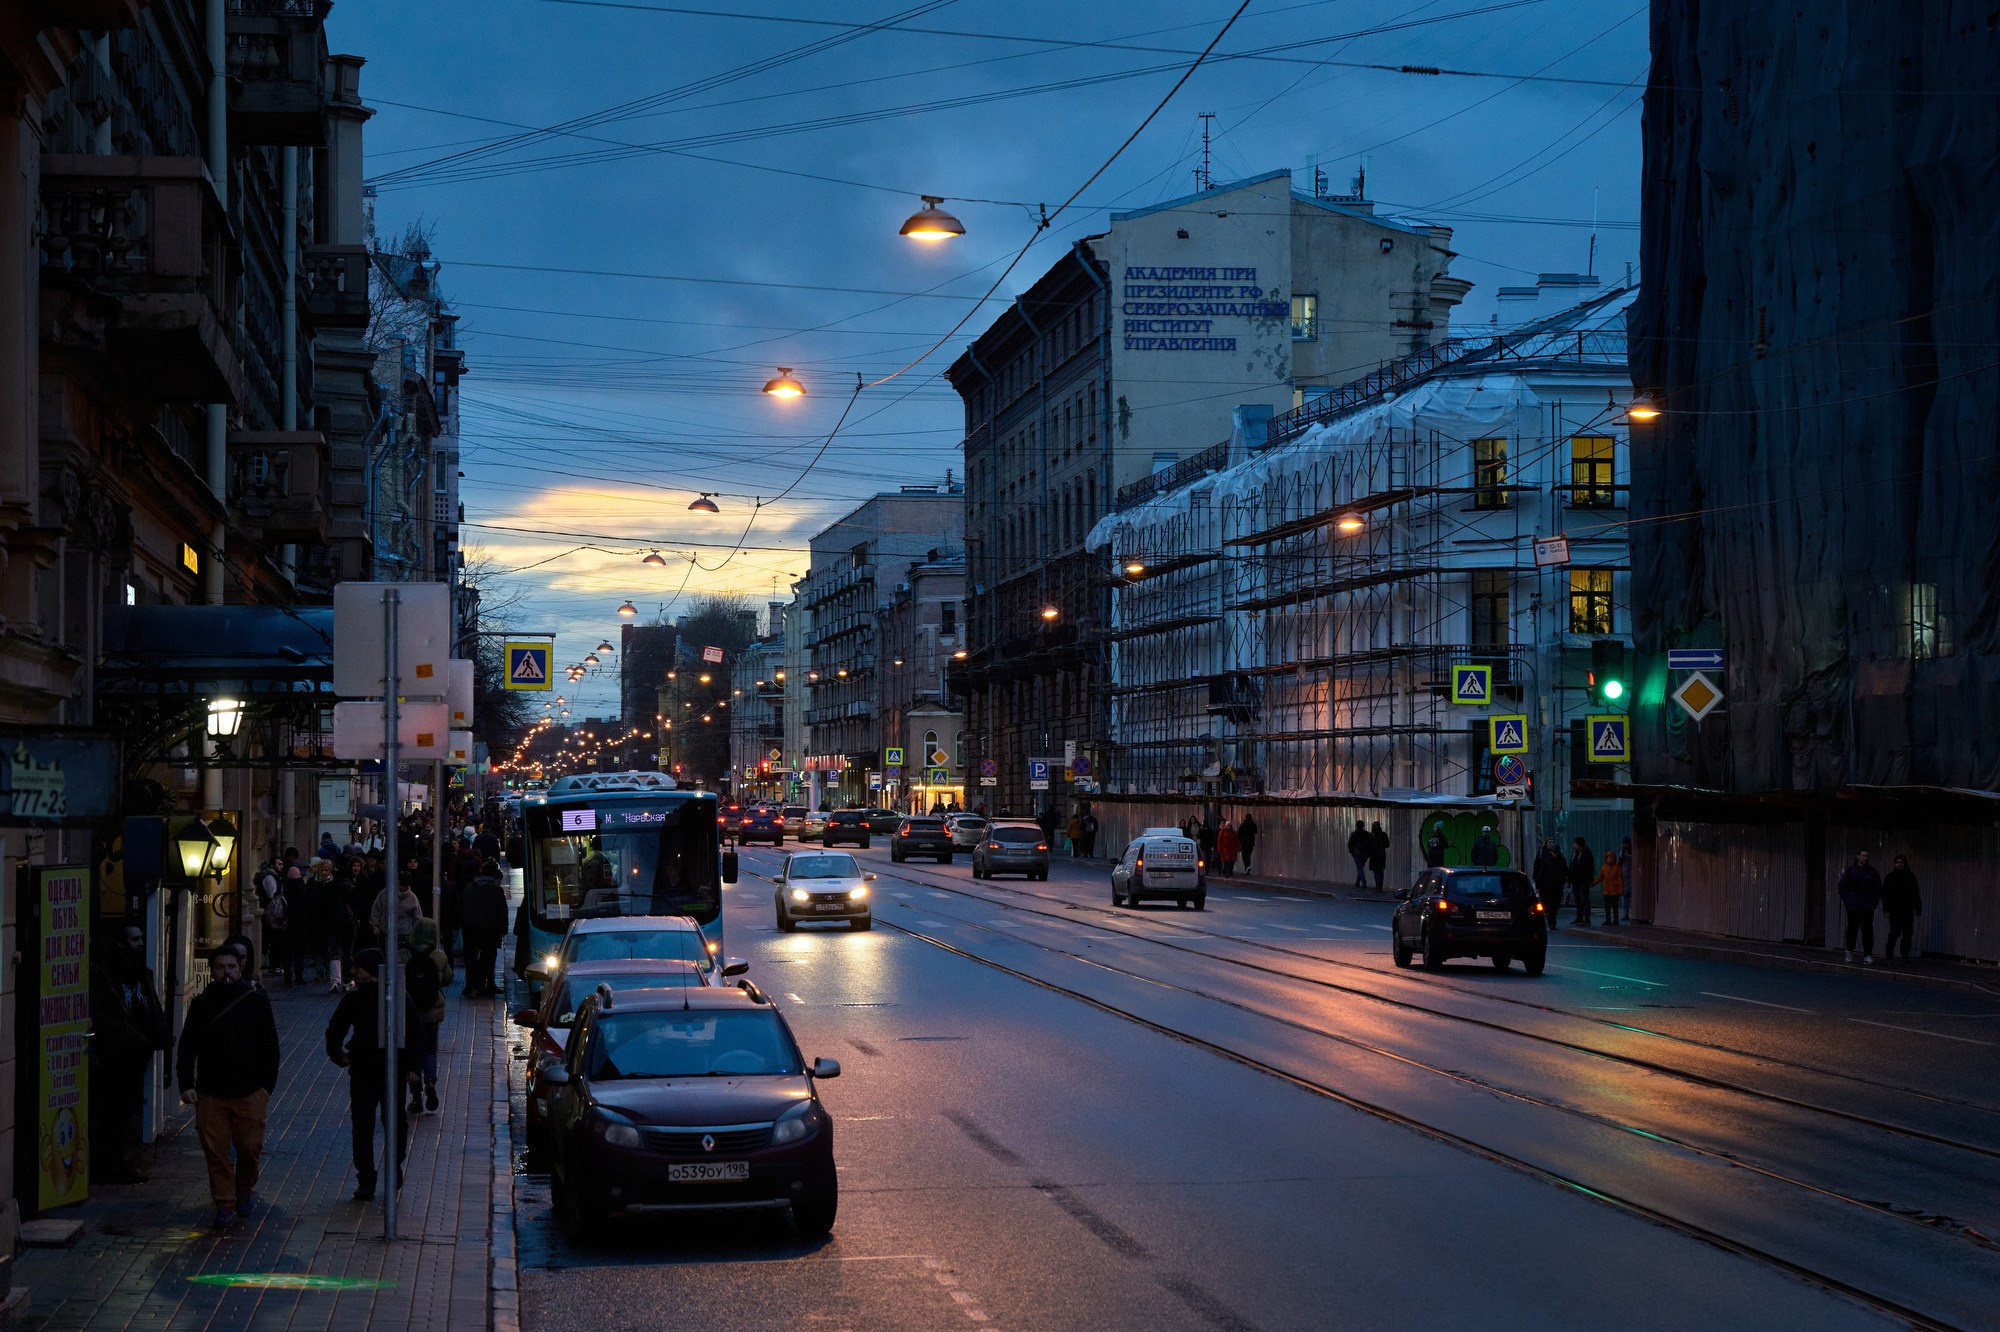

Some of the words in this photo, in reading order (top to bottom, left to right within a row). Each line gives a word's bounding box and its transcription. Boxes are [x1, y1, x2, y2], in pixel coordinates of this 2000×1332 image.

[1124, 267, 1217, 281] АКАДЕМИЯ
[1223, 267, 1257, 281] ПРИ
[1124, 285, 1234, 300] ПРЕЗИДЕНТЕ
[1240, 285, 1263, 299] РФ
[1122, 302, 1290, 317] СЕВЕРО-ЗАПАДНЫЙ
[1124, 319, 1213, 333] ИНСТИТУТ
[1124, 337, 1237, 351] УПРАВЛЕНИЯ
[574, 814, 583, 825] 6
[604, 813, 615, 824] М.
[48, 878, 83, 906] ОДЕЖДА
[52, 907, 79, 930] ОБУВЬ
[45, 935, 62, 963] ДЛЯ
[65, 930, 85, 958] ВСЕЙ
[51, 962, 80, 987] СЕМЬИ
